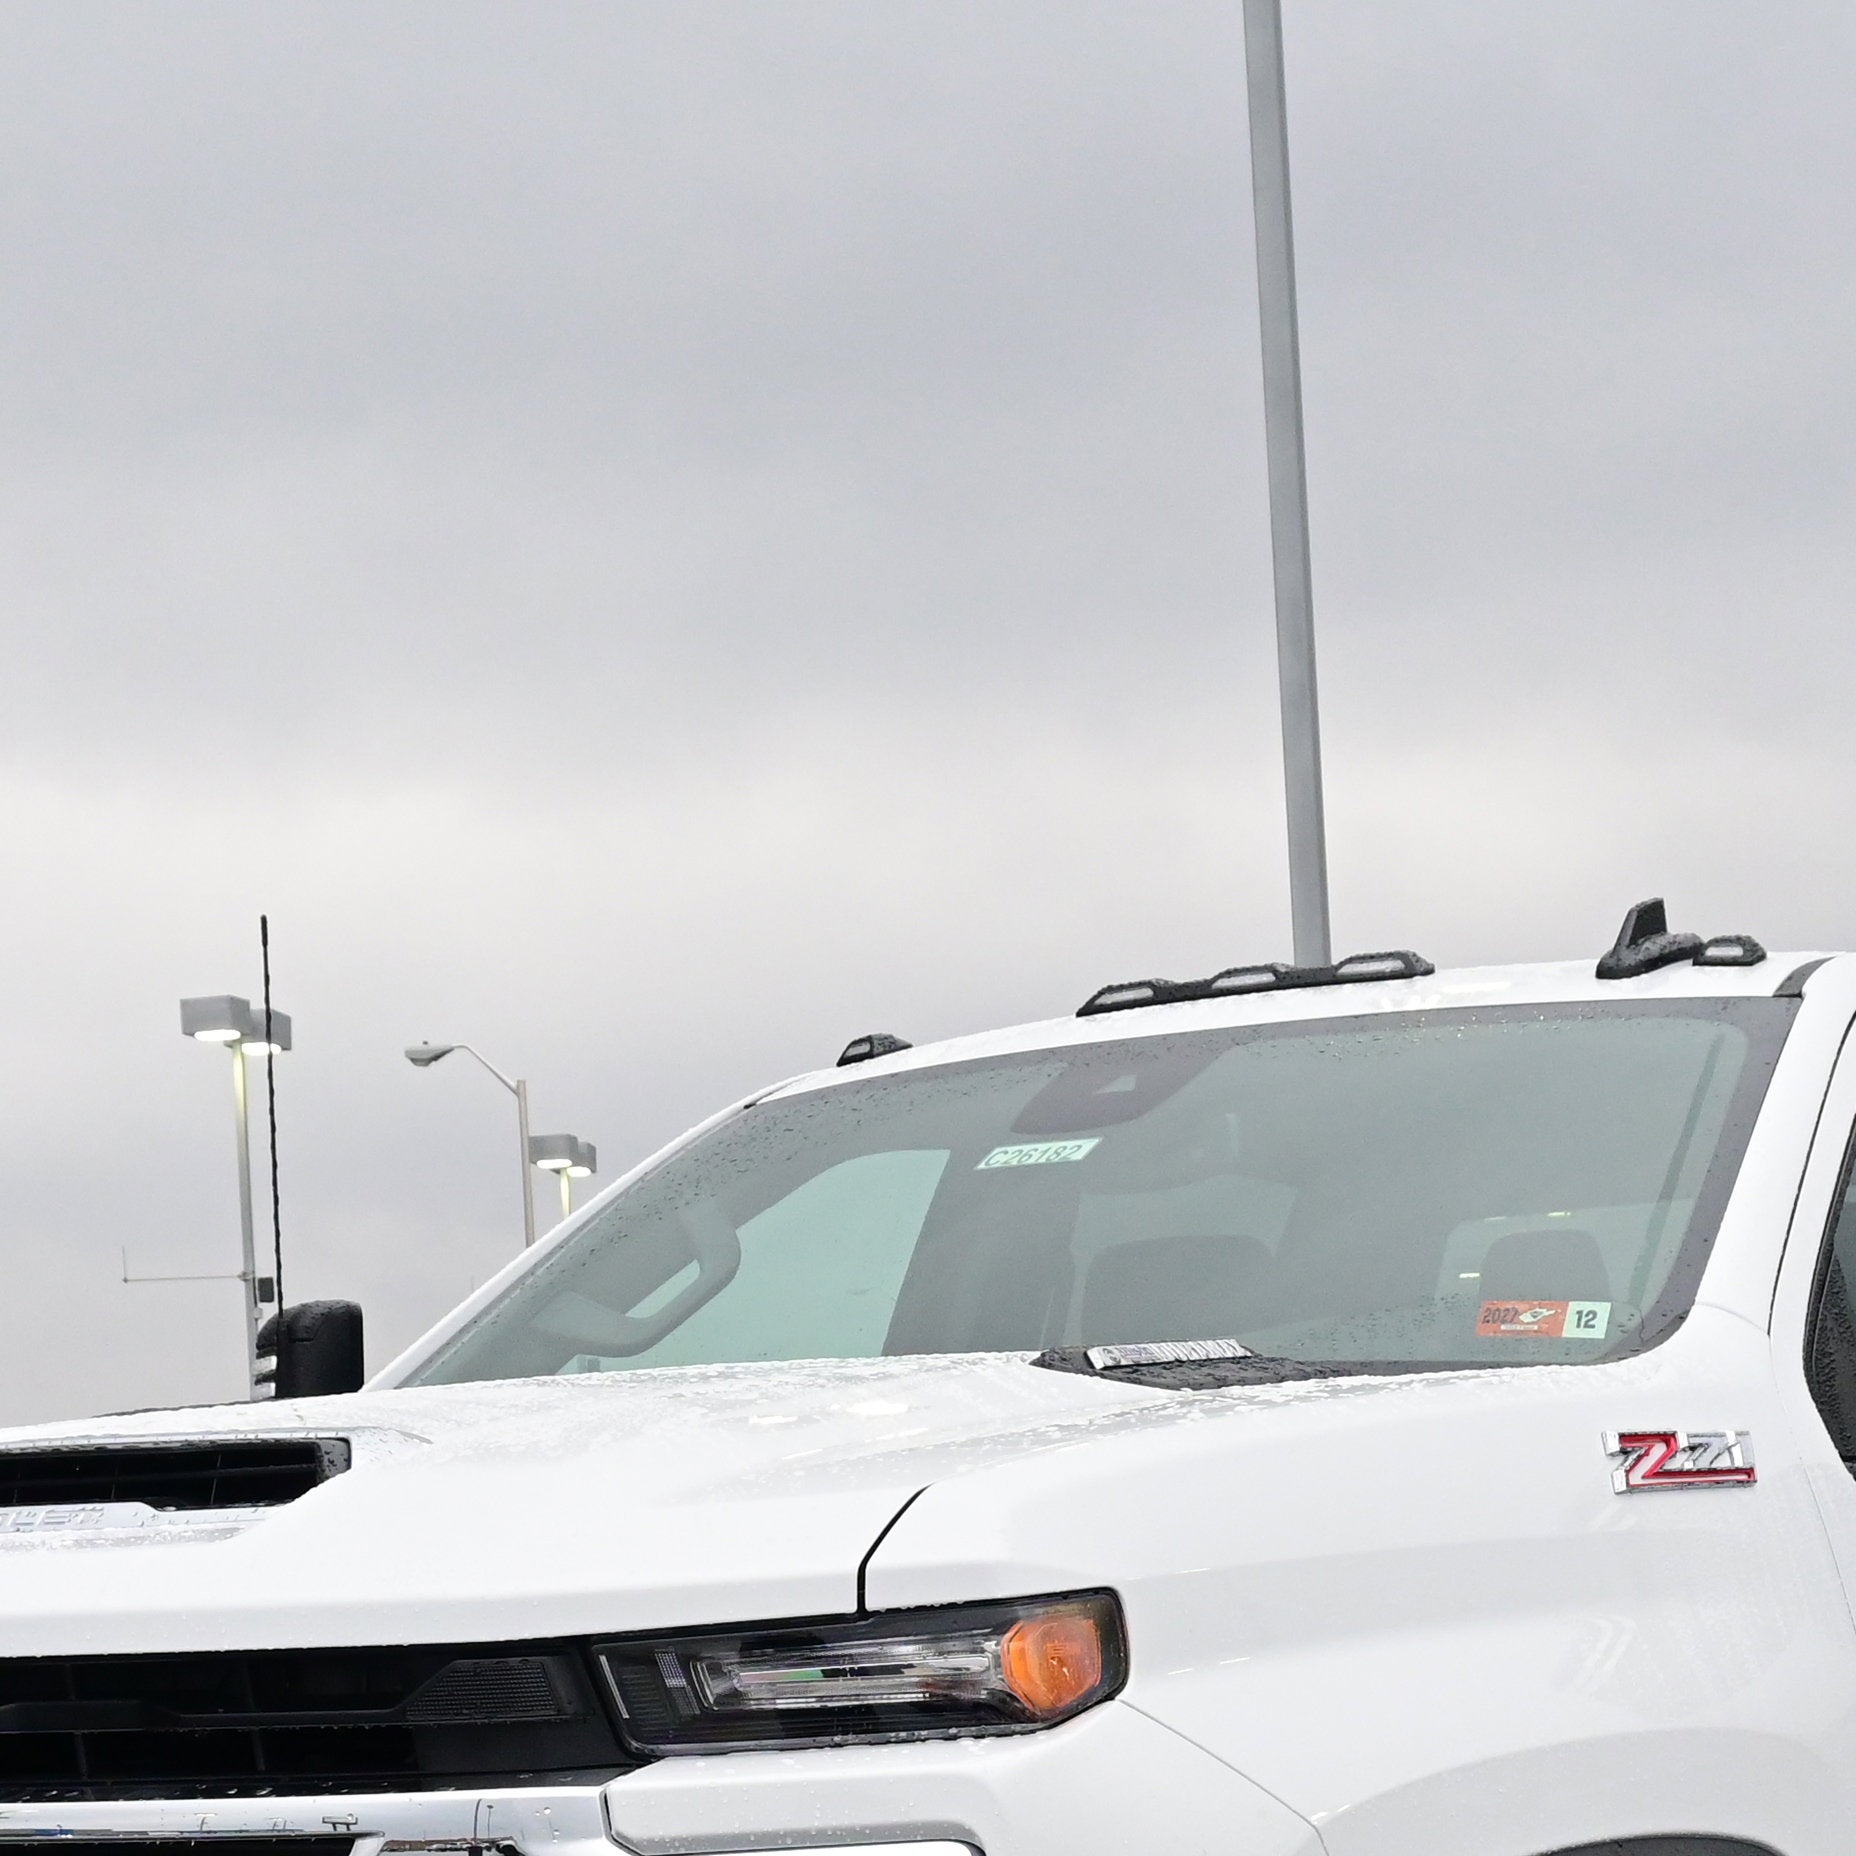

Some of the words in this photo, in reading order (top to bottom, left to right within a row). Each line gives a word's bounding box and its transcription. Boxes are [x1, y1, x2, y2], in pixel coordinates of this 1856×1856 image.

[985, 1145, 1083, 1167] C26182
[1575, 1309, 1599, 1329] 12
[1601, 1430, 1758, 1495] Z71
